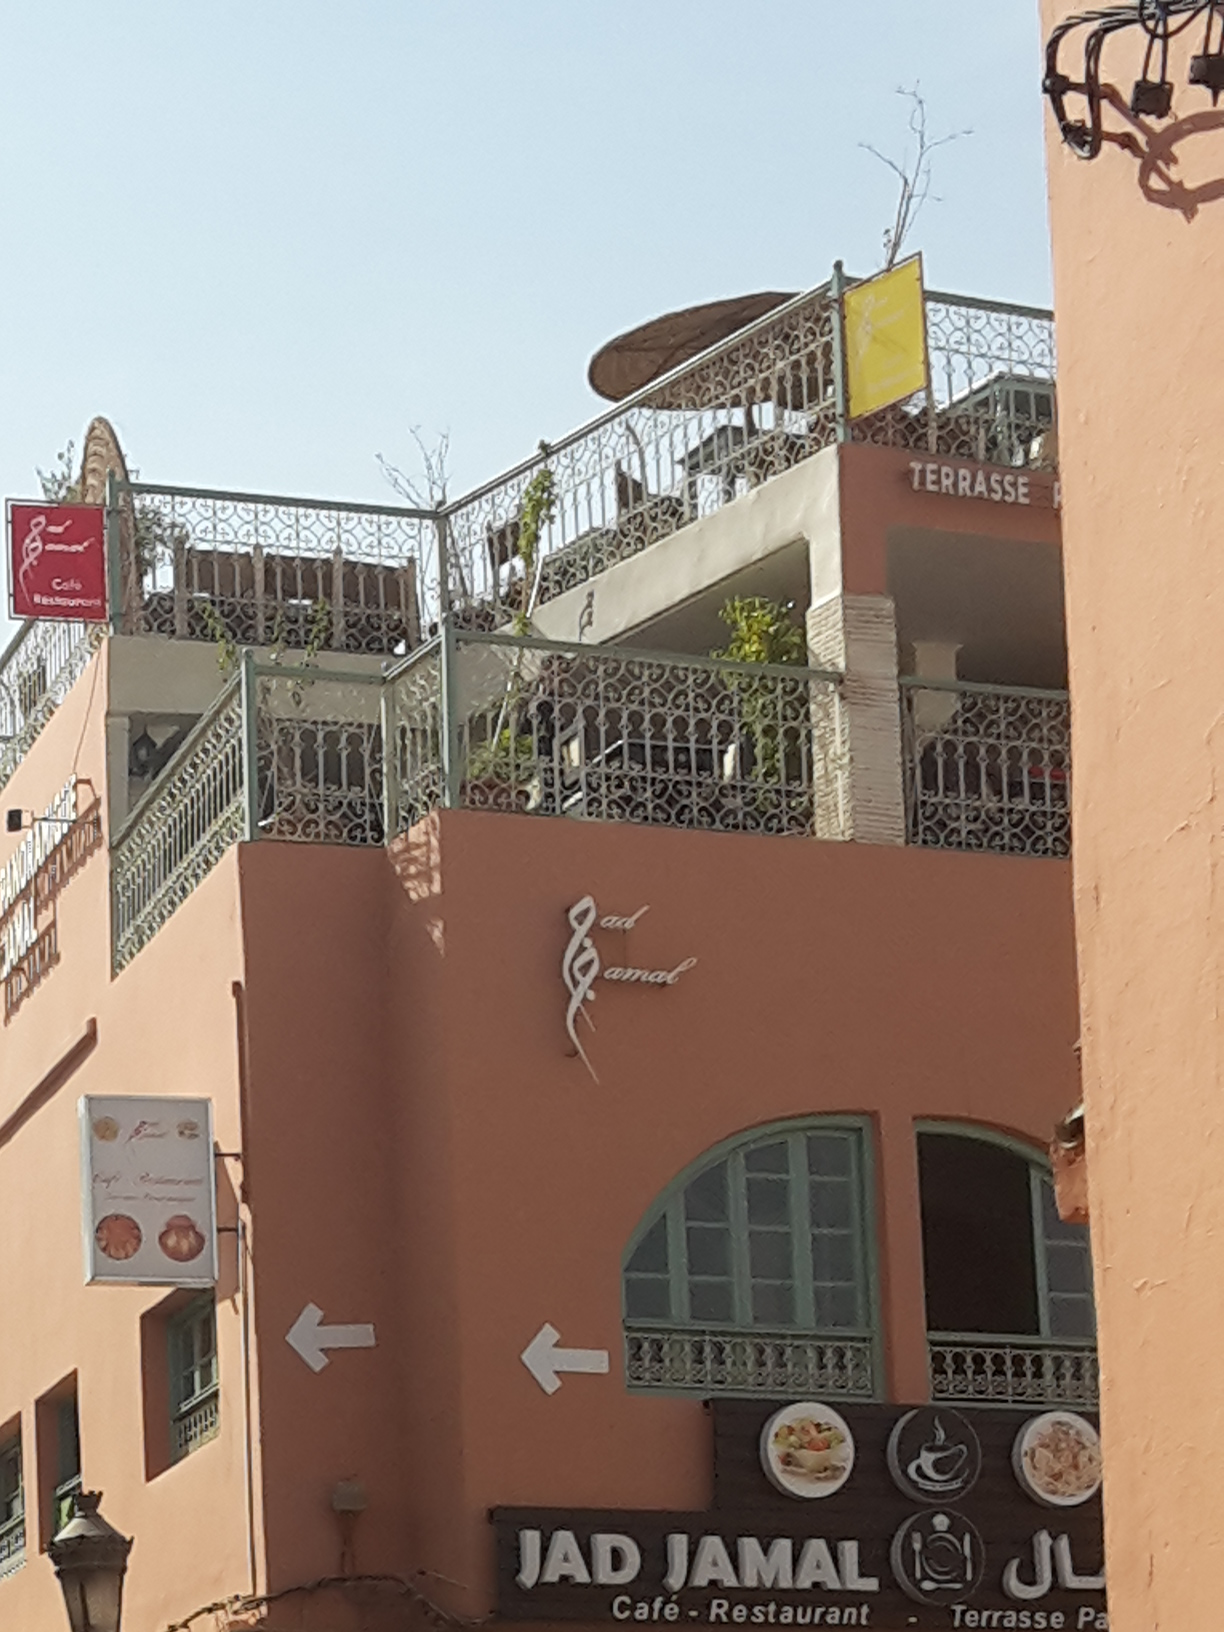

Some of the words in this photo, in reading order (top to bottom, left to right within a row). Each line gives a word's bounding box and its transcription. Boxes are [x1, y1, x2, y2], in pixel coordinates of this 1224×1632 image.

[909, 461, 1030, 505] TERRASSE
[515, 1529, 642, 1590] JAD
[662, 1533, 880, 1592] JAMAL
[612, 1594, 680, 1621] Café
[708, 1599, 870, 1627] Restaurant
[950, 1604, 1066, 1630] Terrasse
